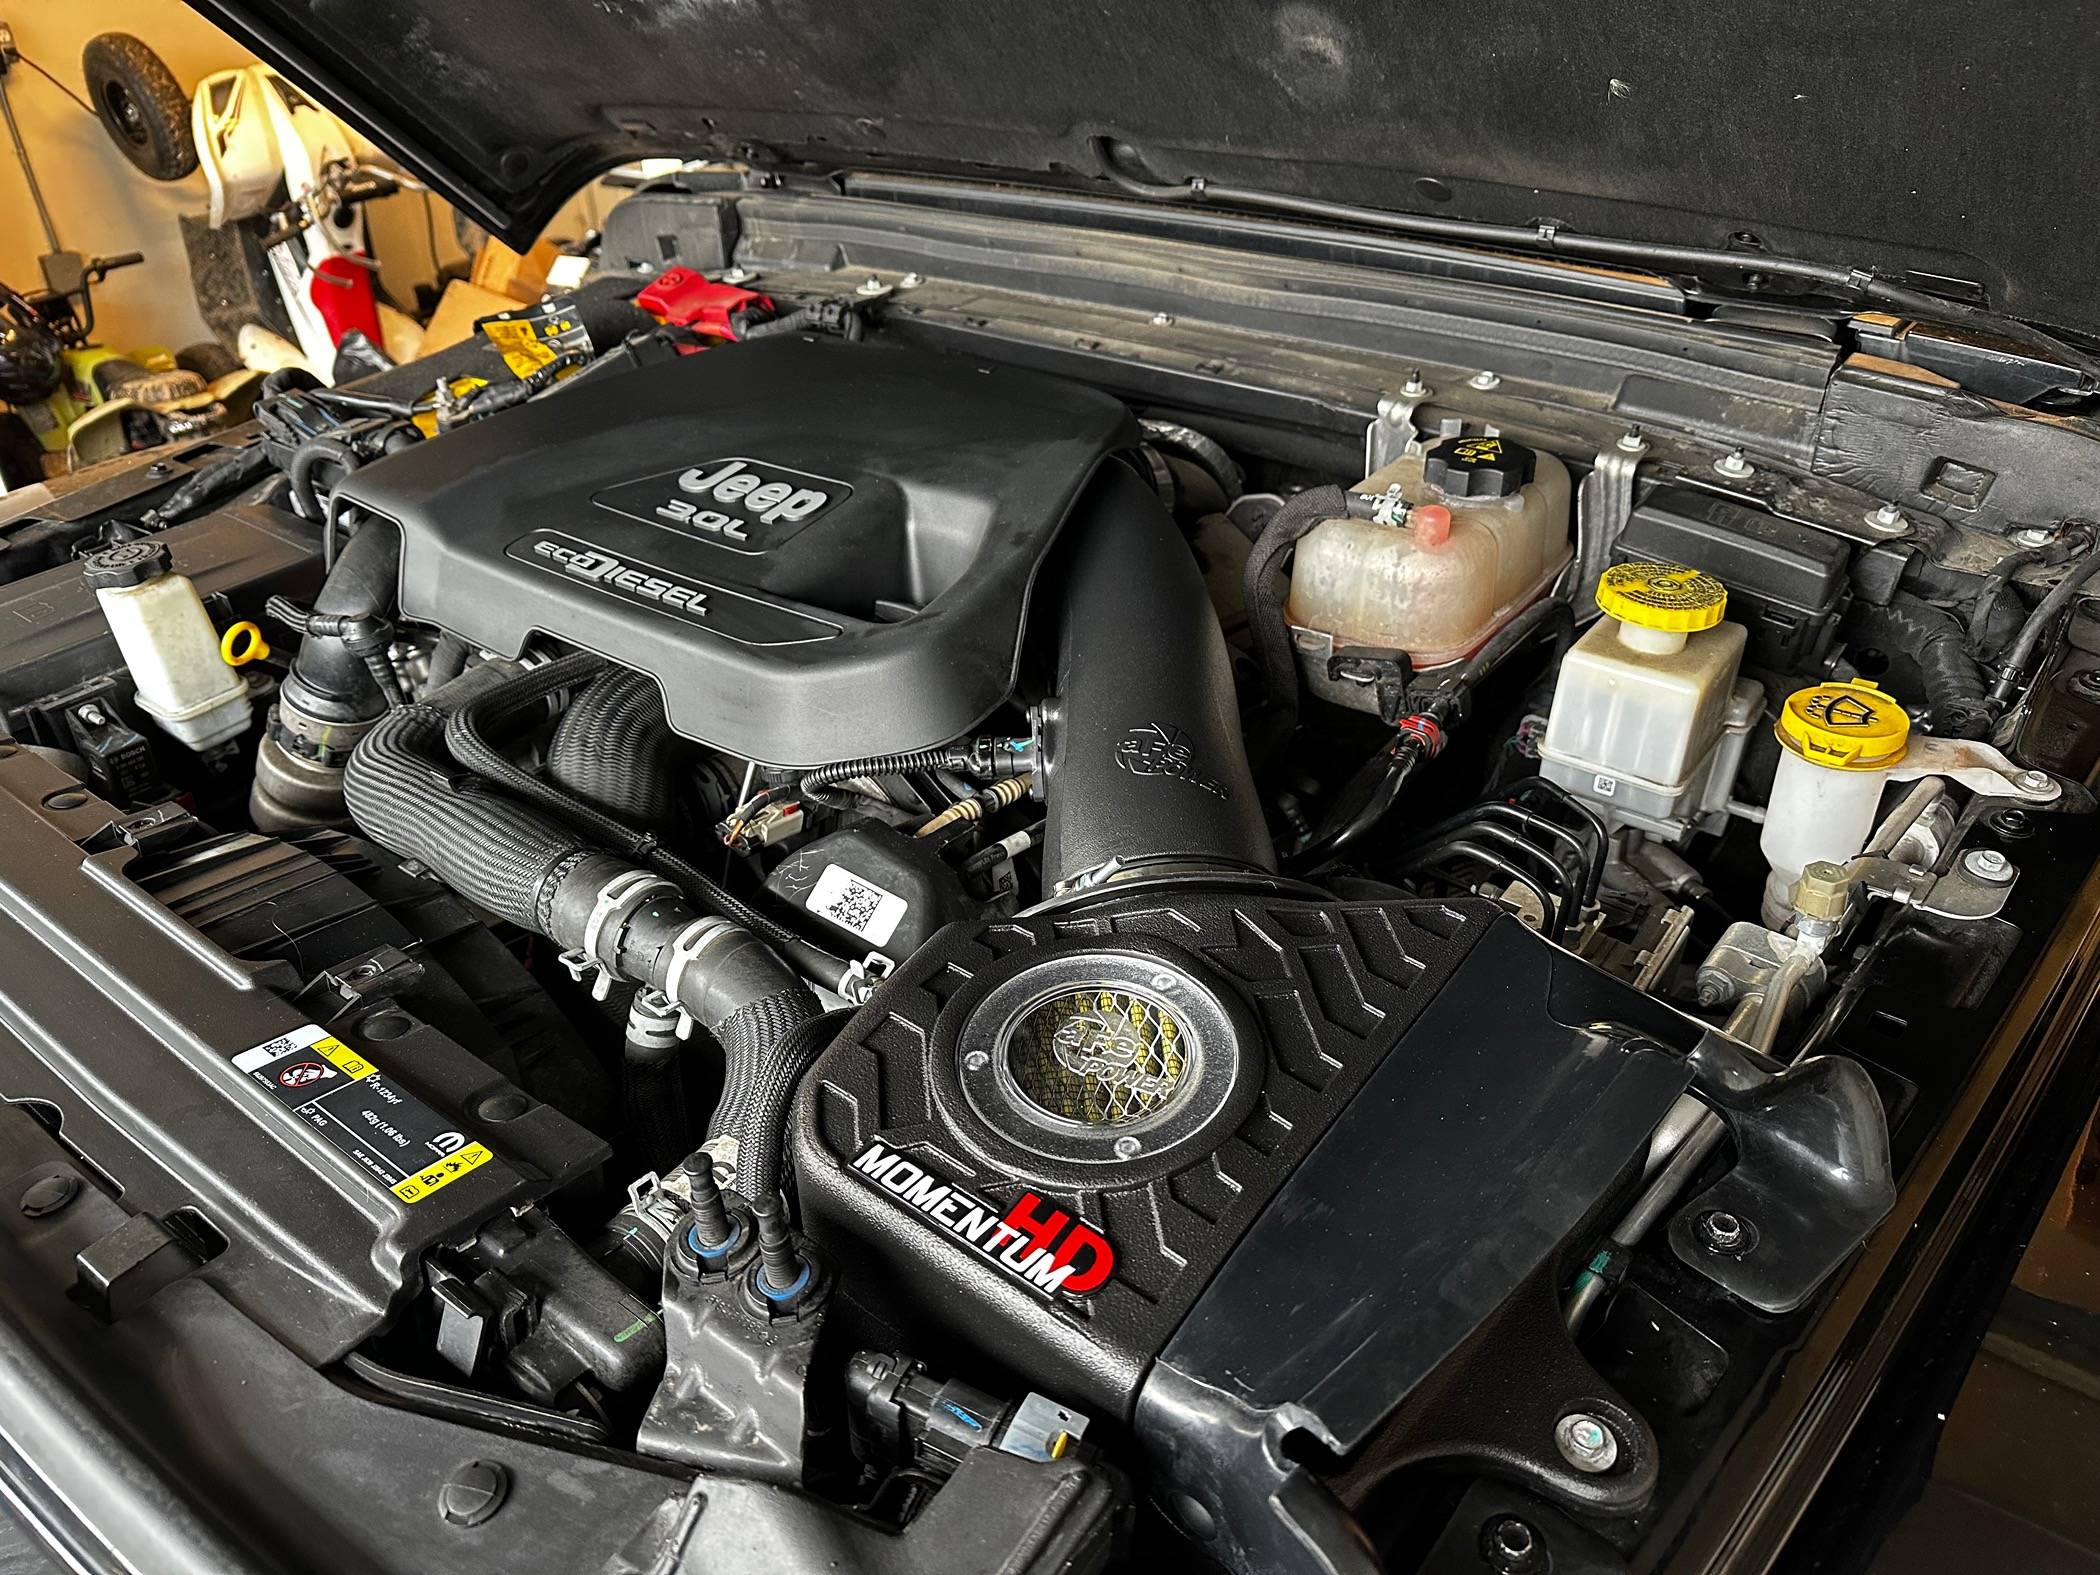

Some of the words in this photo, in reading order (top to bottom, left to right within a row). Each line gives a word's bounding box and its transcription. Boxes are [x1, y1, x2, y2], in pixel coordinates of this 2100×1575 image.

[678, 461, 828, 525] Jeep
[656, 498, 748, 541] 3.0L
[369, 1082, 403, 1105] R-1234yf
[1080, 1056, 1178, 1099] POWER
[311, 1114, 328, 1127] PAG
[374, 1121, 398, 1137] (1.06
[392, 1133, 411, 1148] lbs)
[853, 1143, 1076, 1293] MOMENTUM
[992, 1192, 1114, 1292] HD
